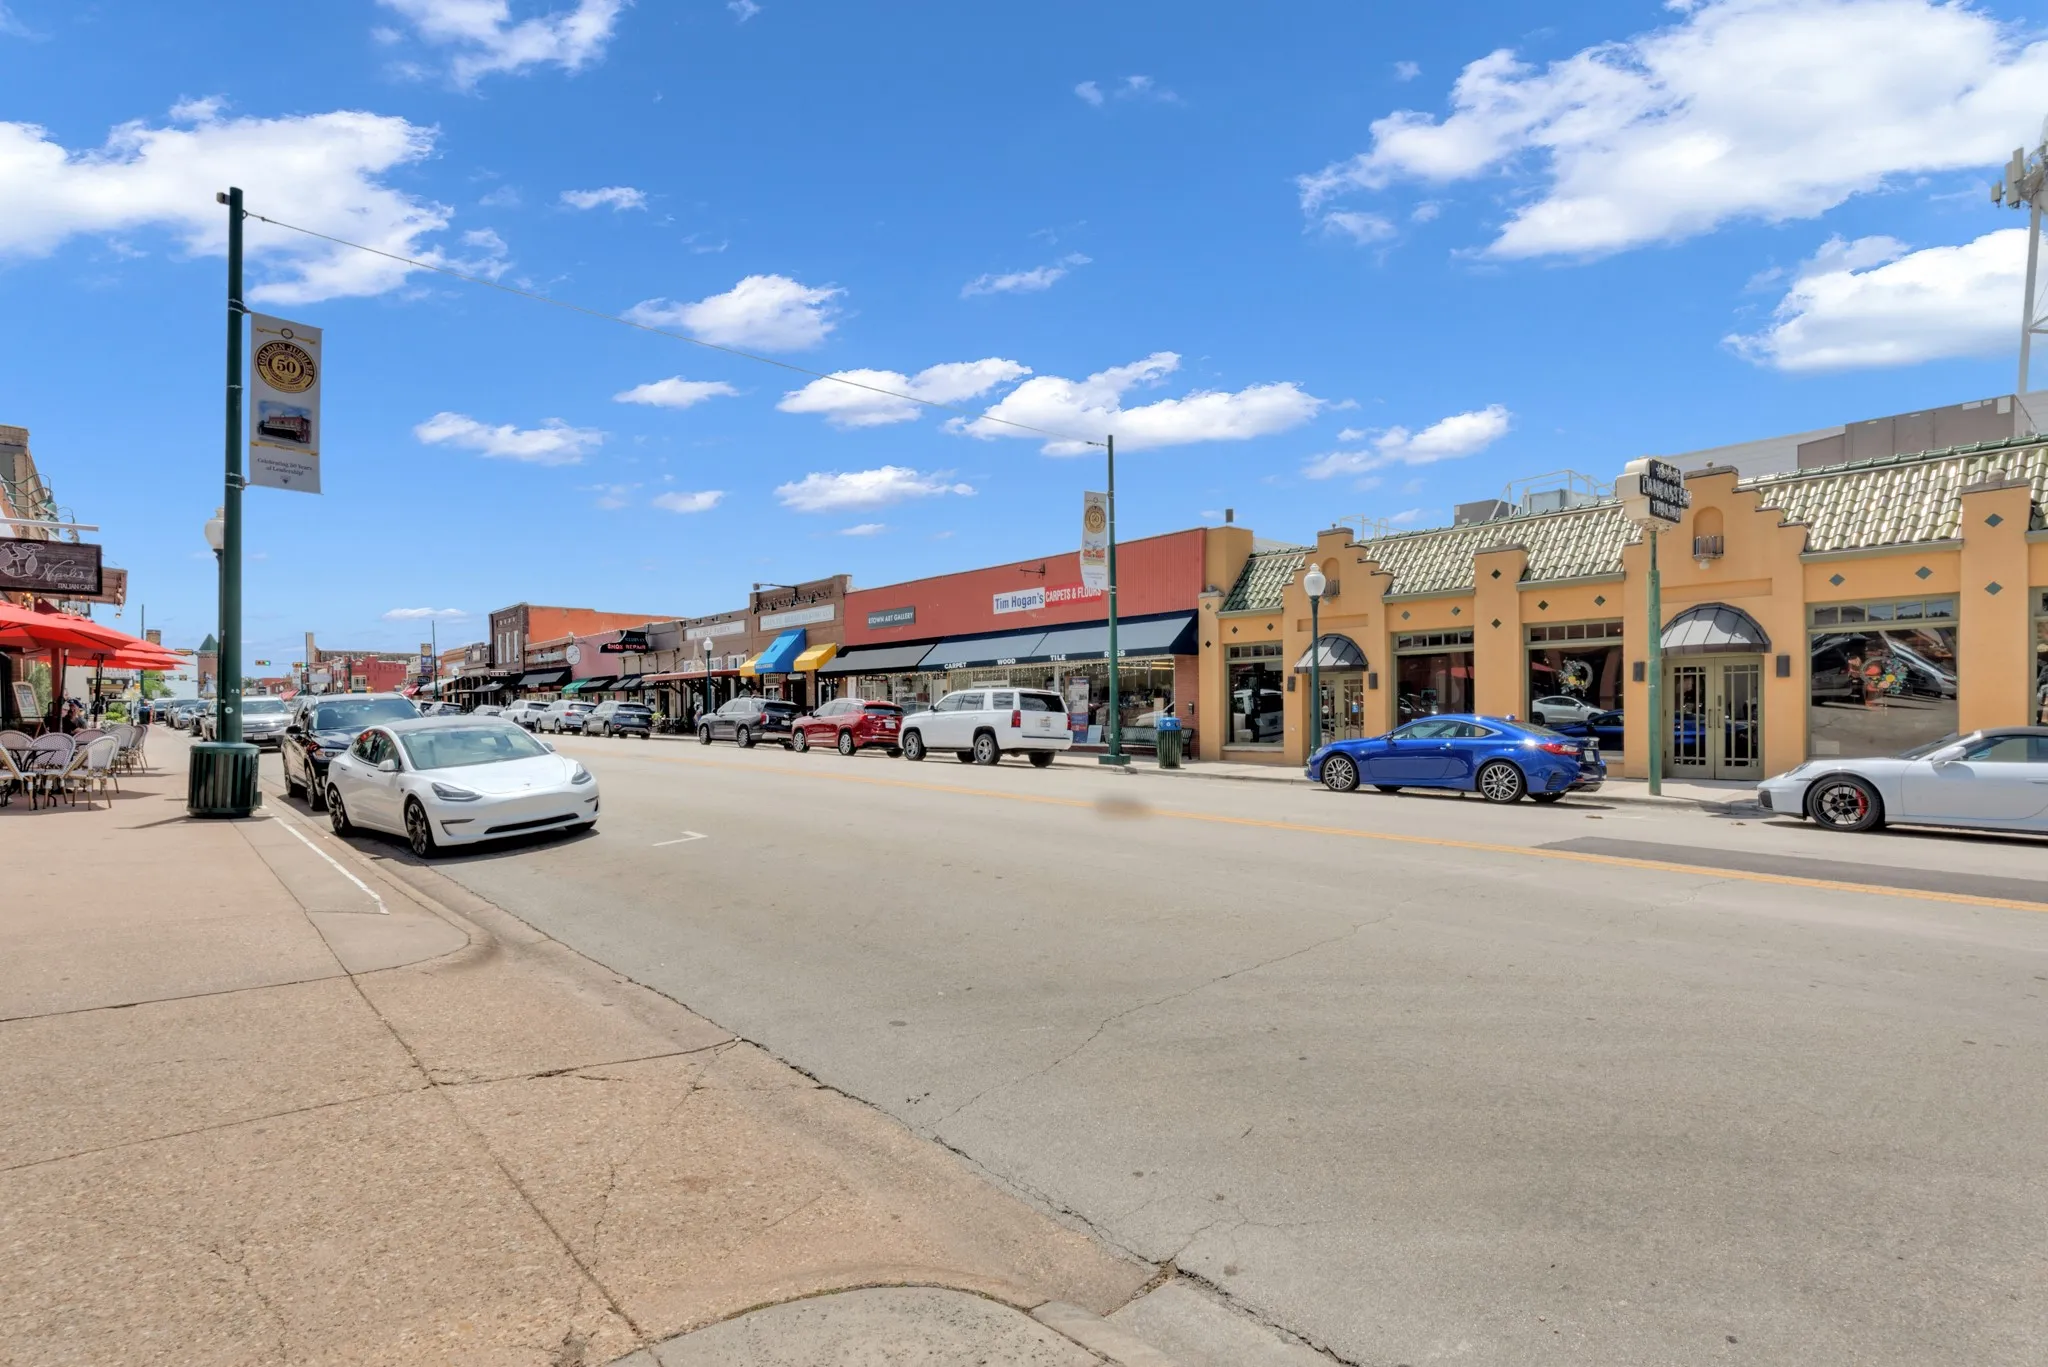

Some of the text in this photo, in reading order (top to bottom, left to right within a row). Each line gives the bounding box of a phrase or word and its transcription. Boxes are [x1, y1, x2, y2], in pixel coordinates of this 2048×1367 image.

[258, 343, 314, 377] GOLDEN JUBILEE
[276, 359, 296, 374] 50
[994, 592, 1044, 610] Tim Hogan's
[1045, 588, 1071, 602] CARPETS
[1071, 587, 1077, 599] &
[894, 612, 914, 621] GALLERY
[1104, 650, 1126, 658] RGS
[943, 661, 967, 669] CARPET
